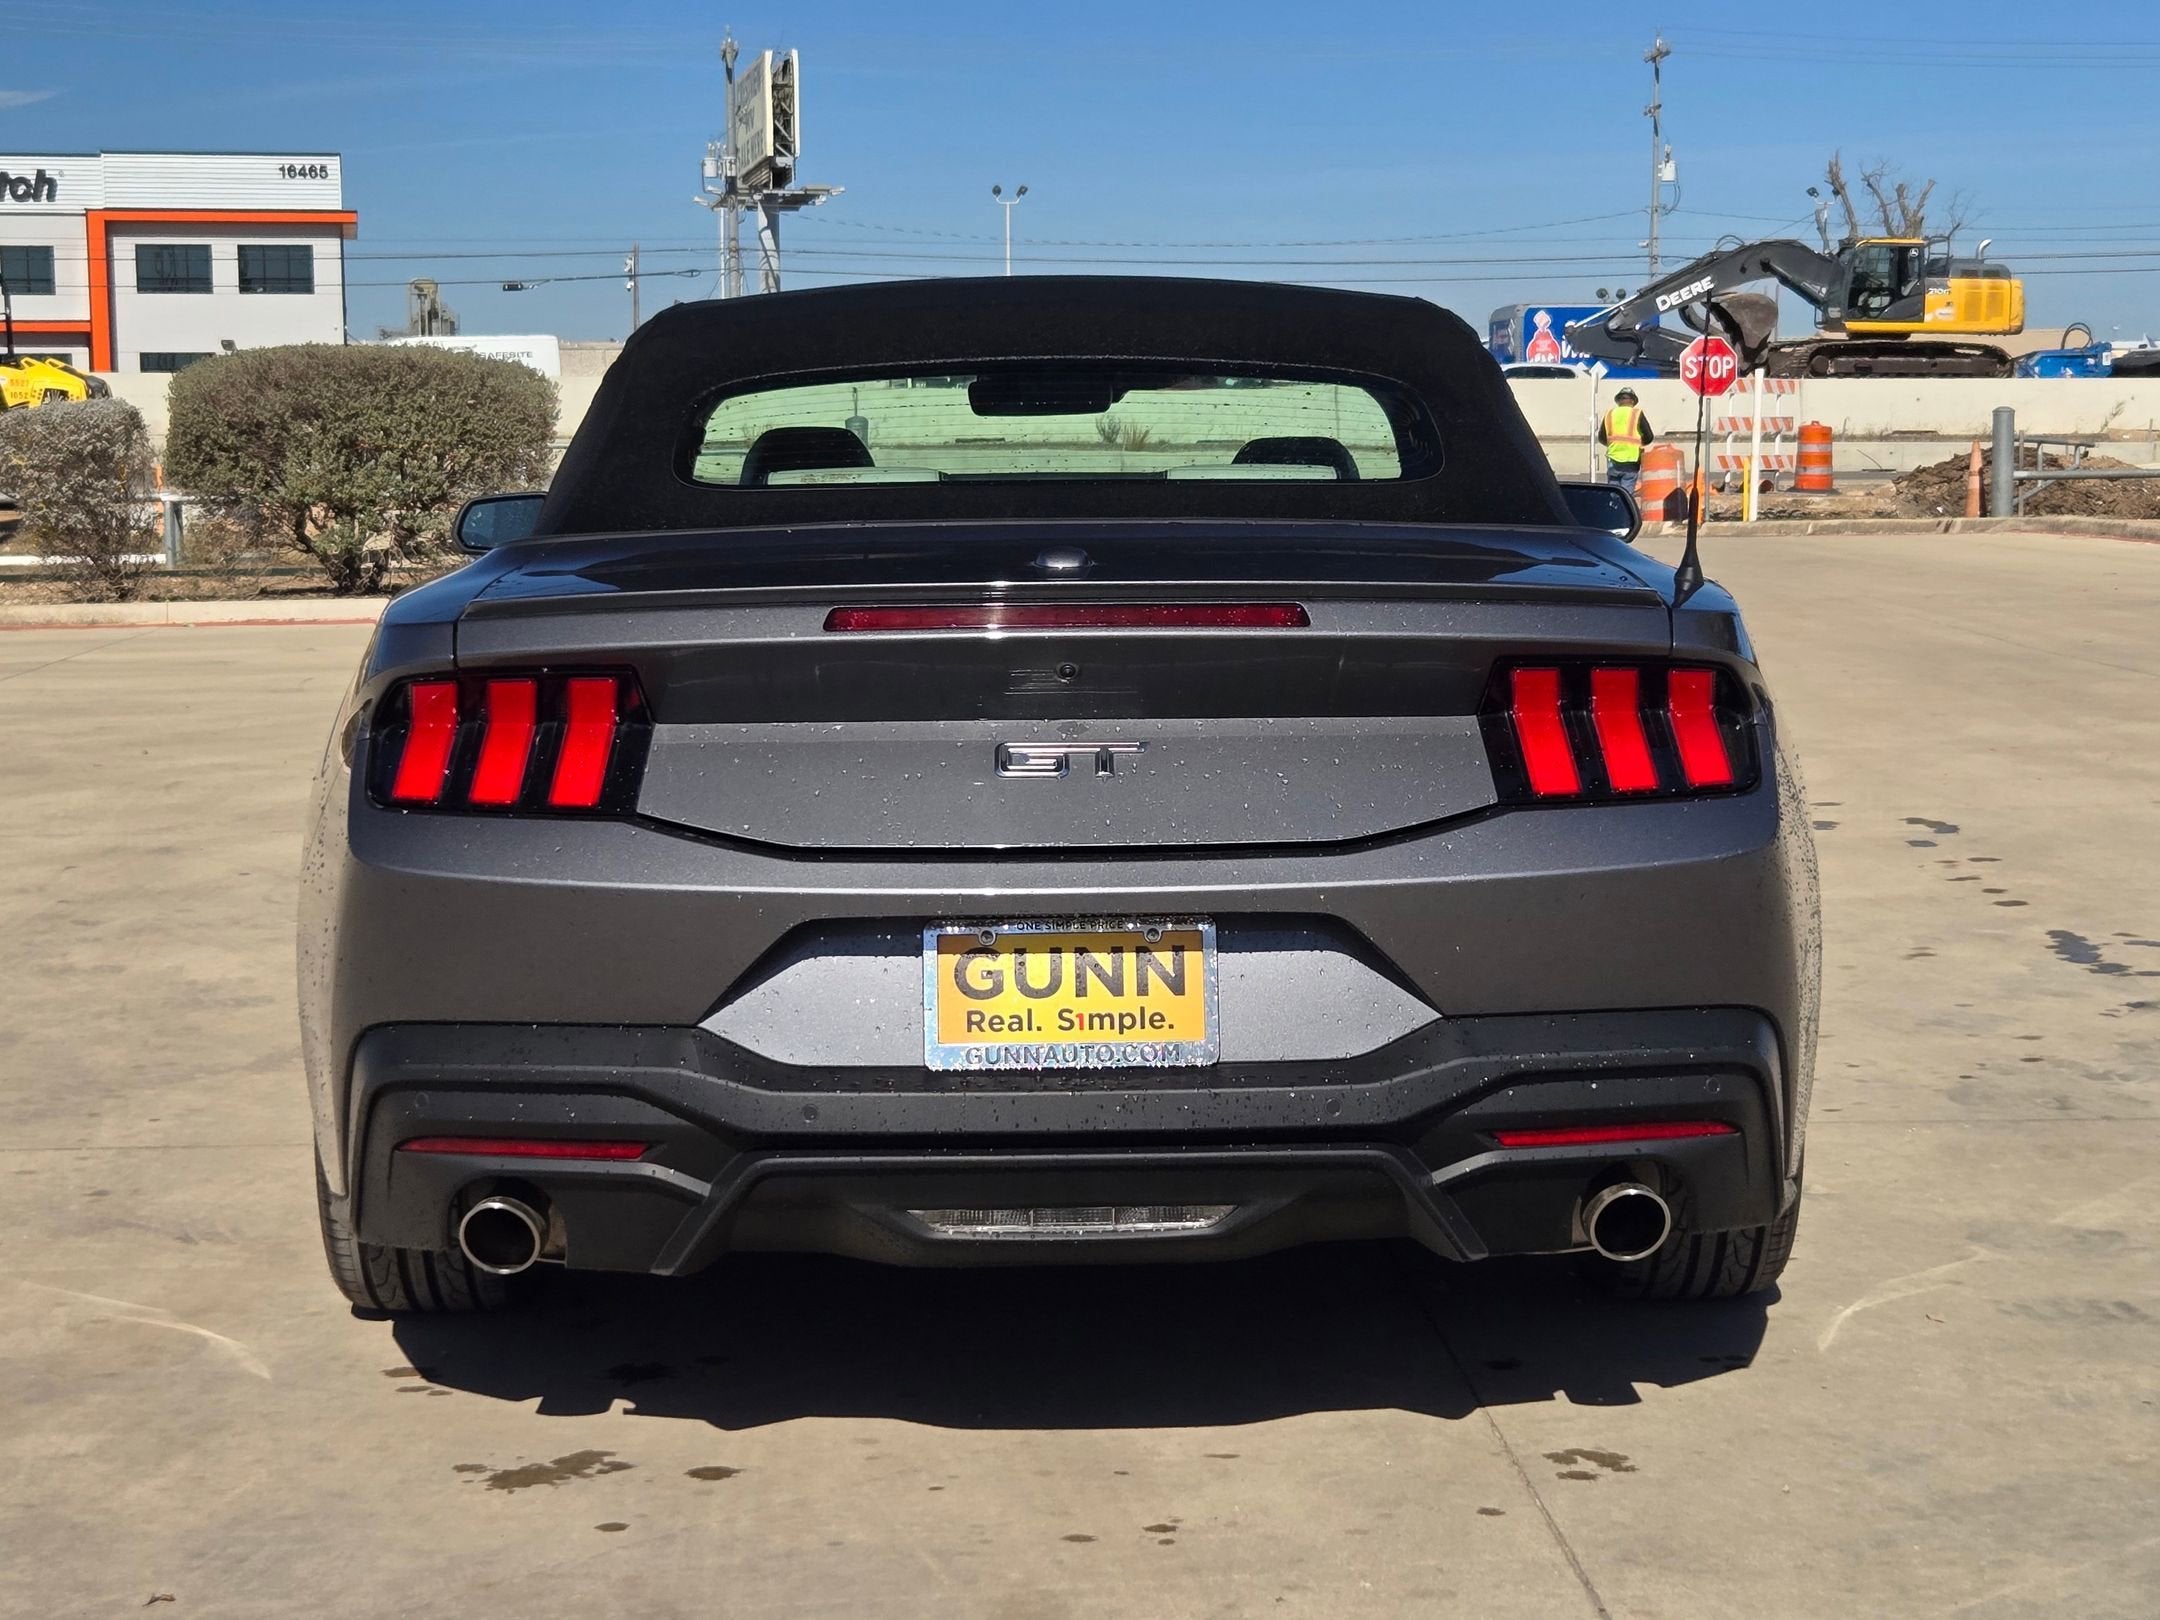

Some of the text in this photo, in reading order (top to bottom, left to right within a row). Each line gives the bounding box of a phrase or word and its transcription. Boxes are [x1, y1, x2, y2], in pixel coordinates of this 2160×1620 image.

[279, 164, 329, 180] 16465
[1655, 275, 1715, 312] DEERE
[994, 741, 1148, 779] GT
[1016, 919, 1124, 931] ONE SIMPLE PRICE
[954, 945, 1186, 1000] GUNN
[966, 1009, 1043, 1033] Real.
[965, 1042, 1182, 1066] GUNNAUTO.COM
